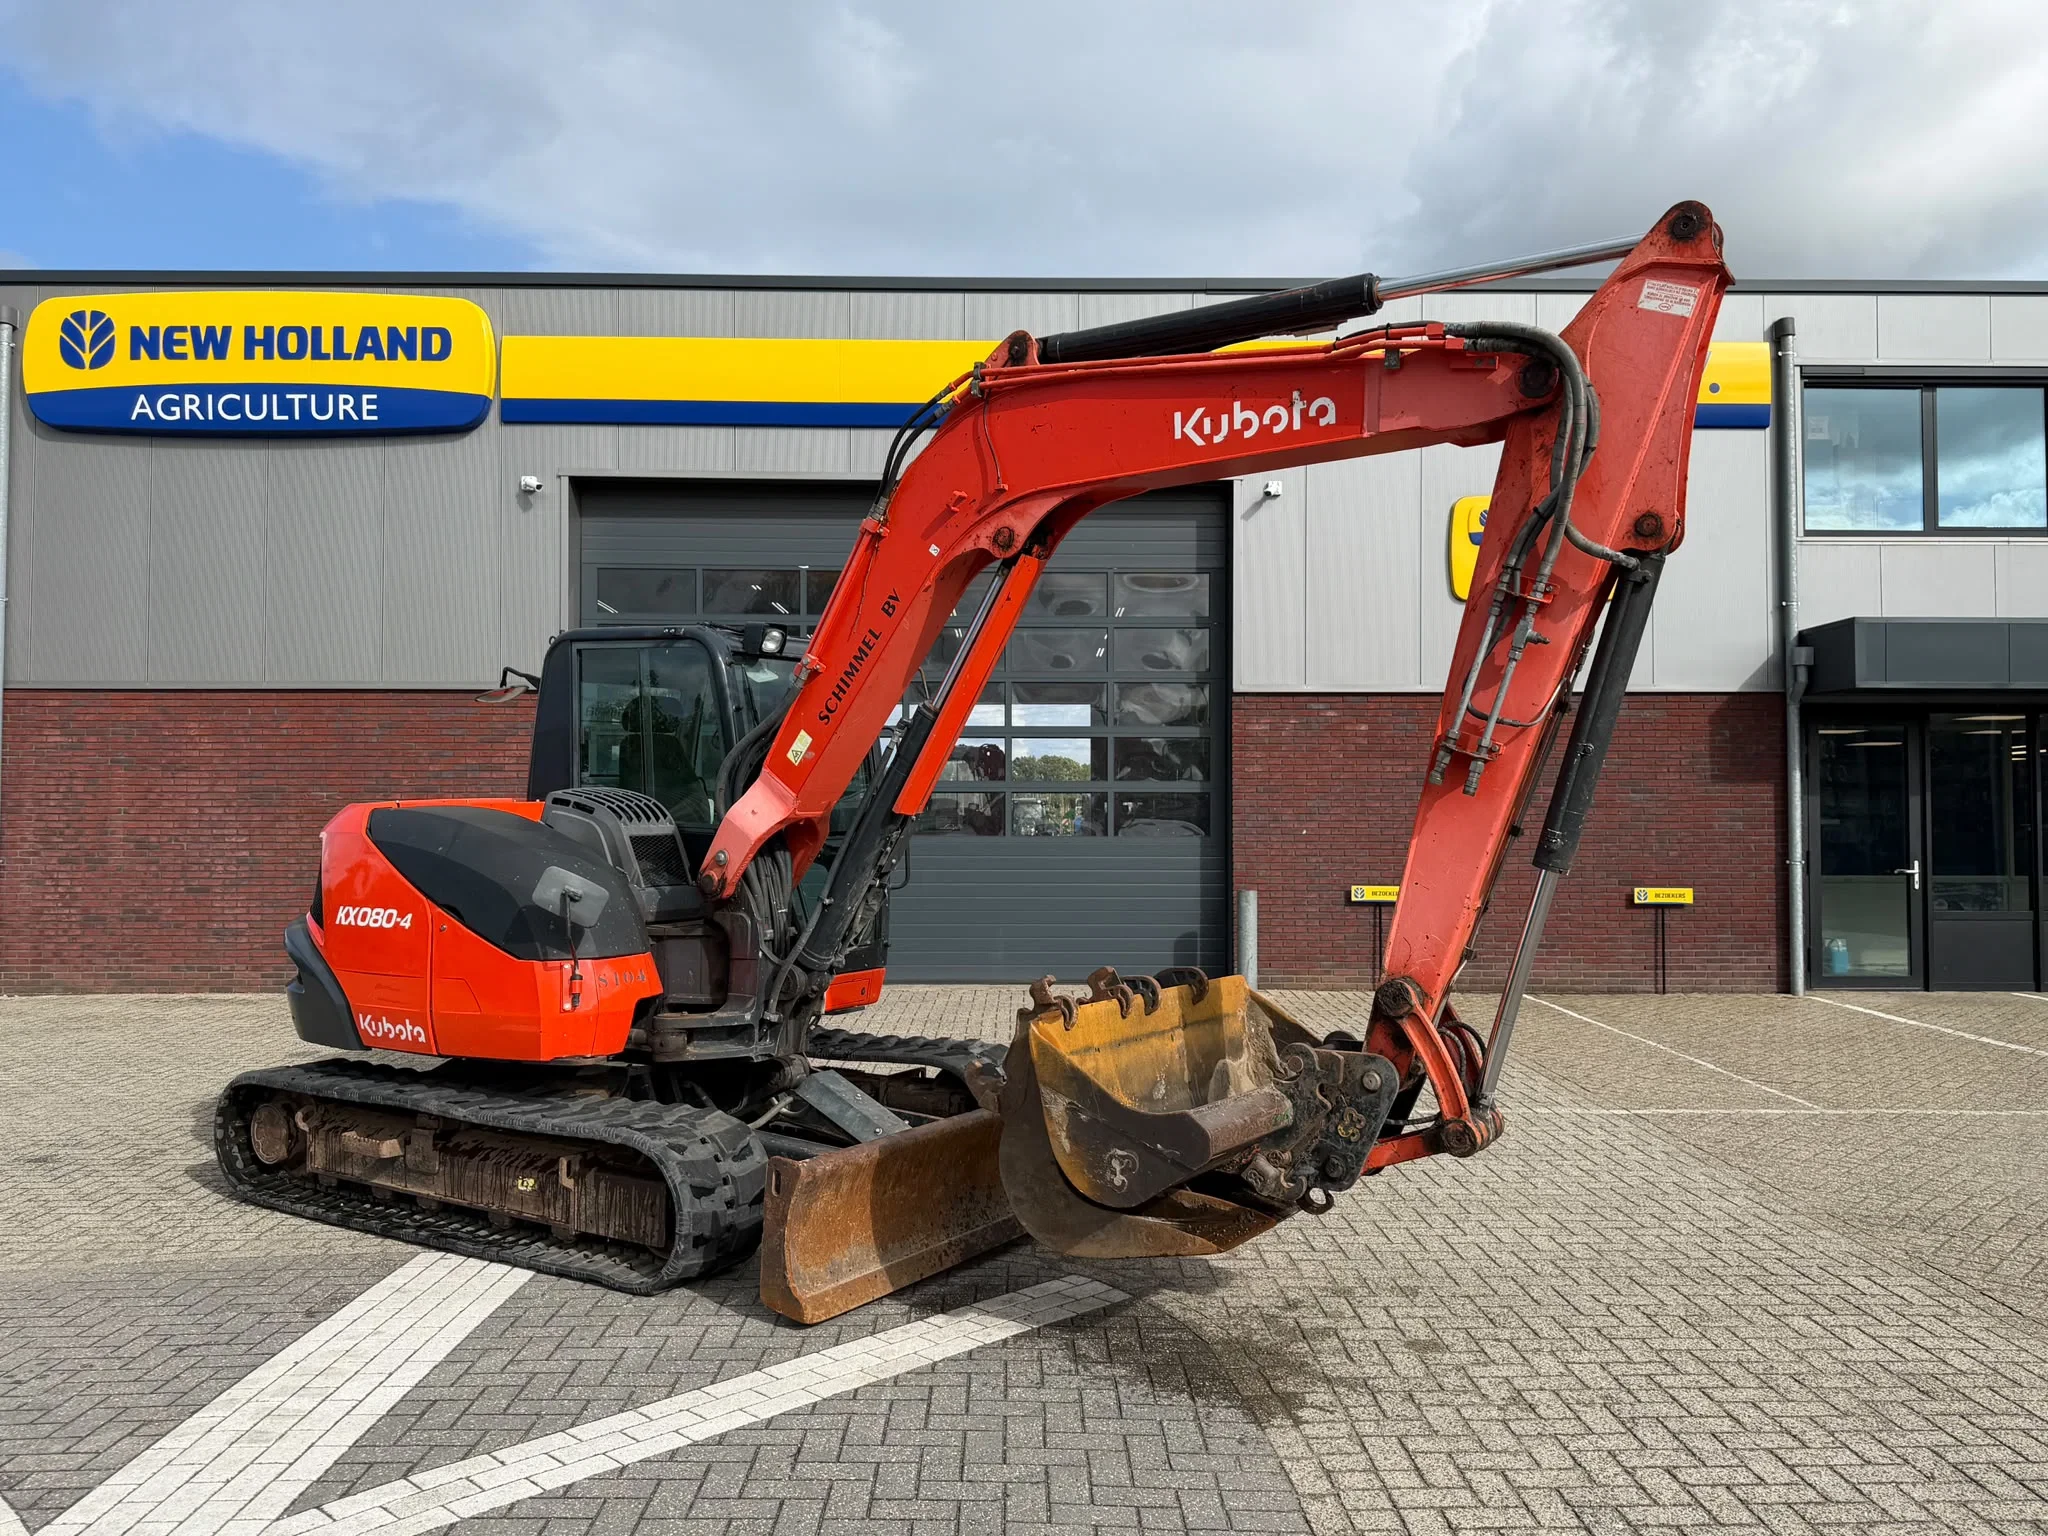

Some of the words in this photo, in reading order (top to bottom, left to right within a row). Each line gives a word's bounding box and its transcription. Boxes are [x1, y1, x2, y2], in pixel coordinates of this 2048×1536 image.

[130, 325, 232, 361] NEW
[243, 325, 453, 362] HOLLAND
[131, 394, 379, 421] AGRICULTURE
[1174, 391, 1336, 446] Kubota
[818, 628, 883, 726] SCHIMMEL
[880, 588, 901, 619] BV
[335, 905, 413, 930] KX080-4
[358, 1013, 427, 1044] Kubota
